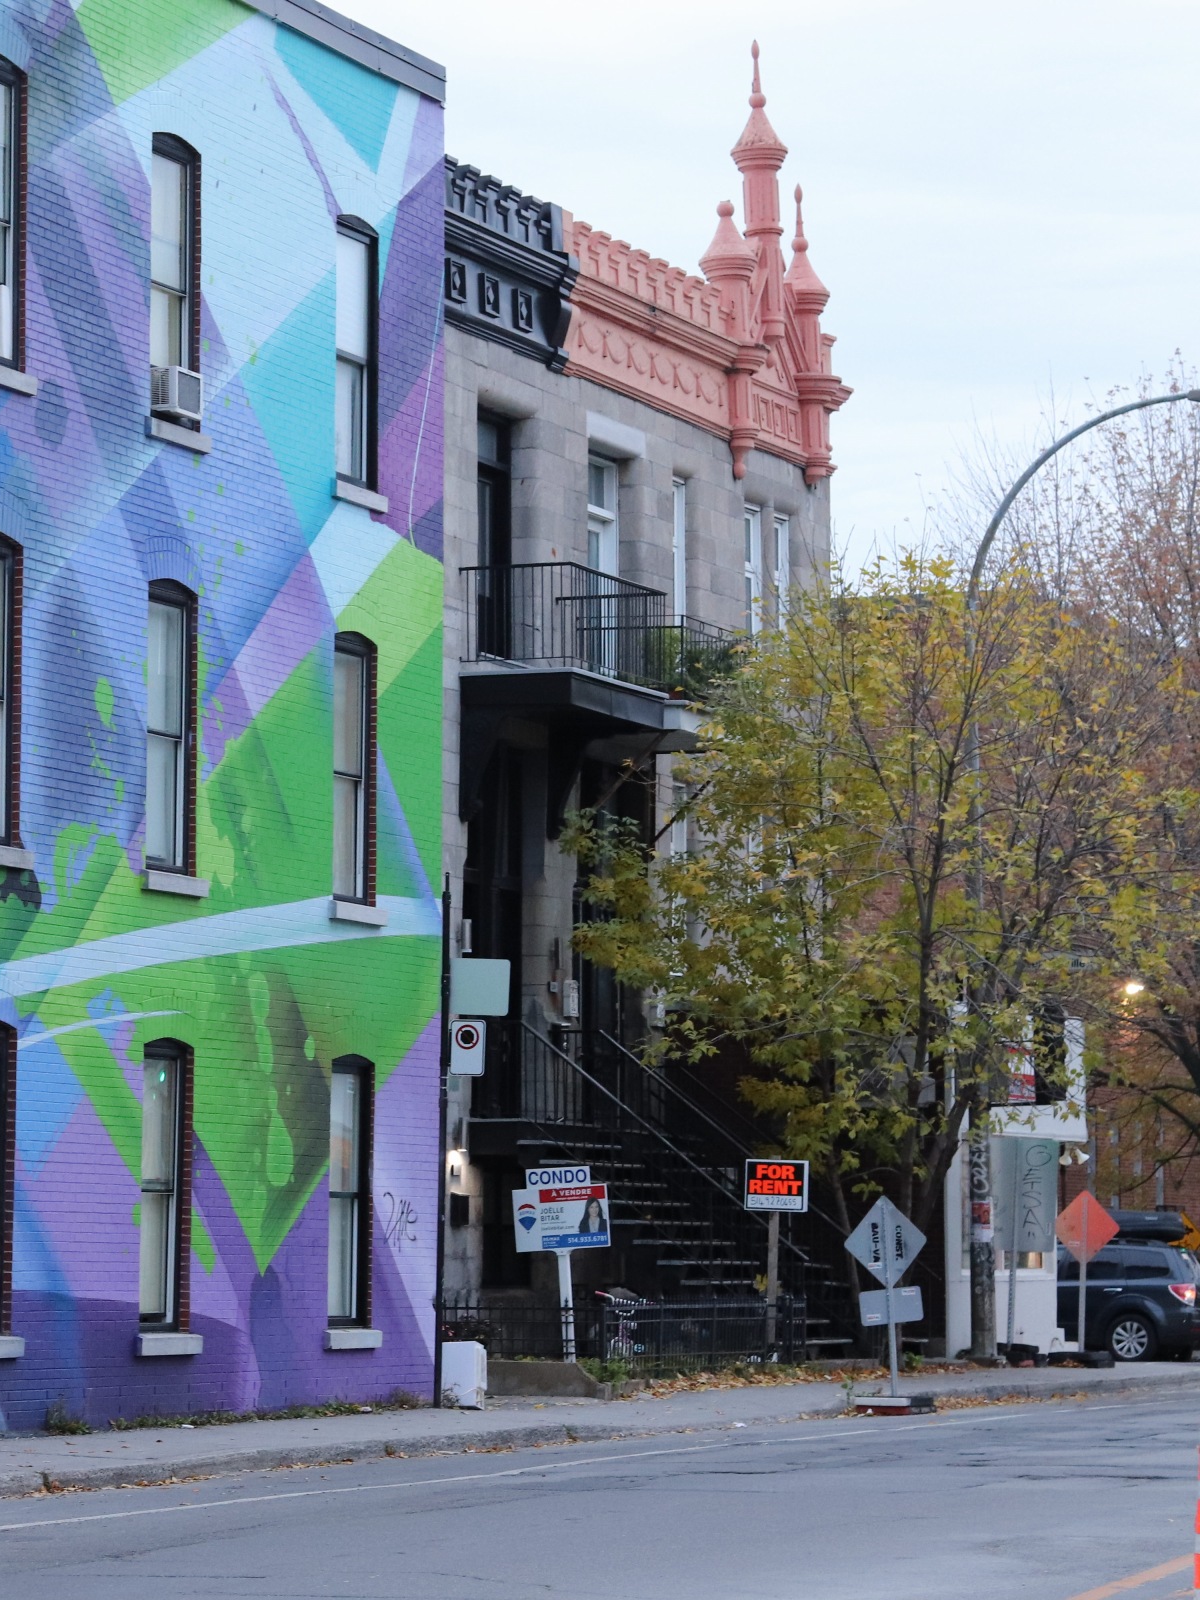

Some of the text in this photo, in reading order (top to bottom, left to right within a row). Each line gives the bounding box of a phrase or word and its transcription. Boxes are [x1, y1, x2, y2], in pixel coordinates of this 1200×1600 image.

[528, 1169, 587, 1185] CONDO
[756, 1164, 795, 1180] FOR
[551, 1188, 592, 1197] À VENDRE
[749, 1179, 802, 1195] RENT
[541, 1214, 560, 1222] BITAR
[871, 1222, 880, 1263] BAU-VA
